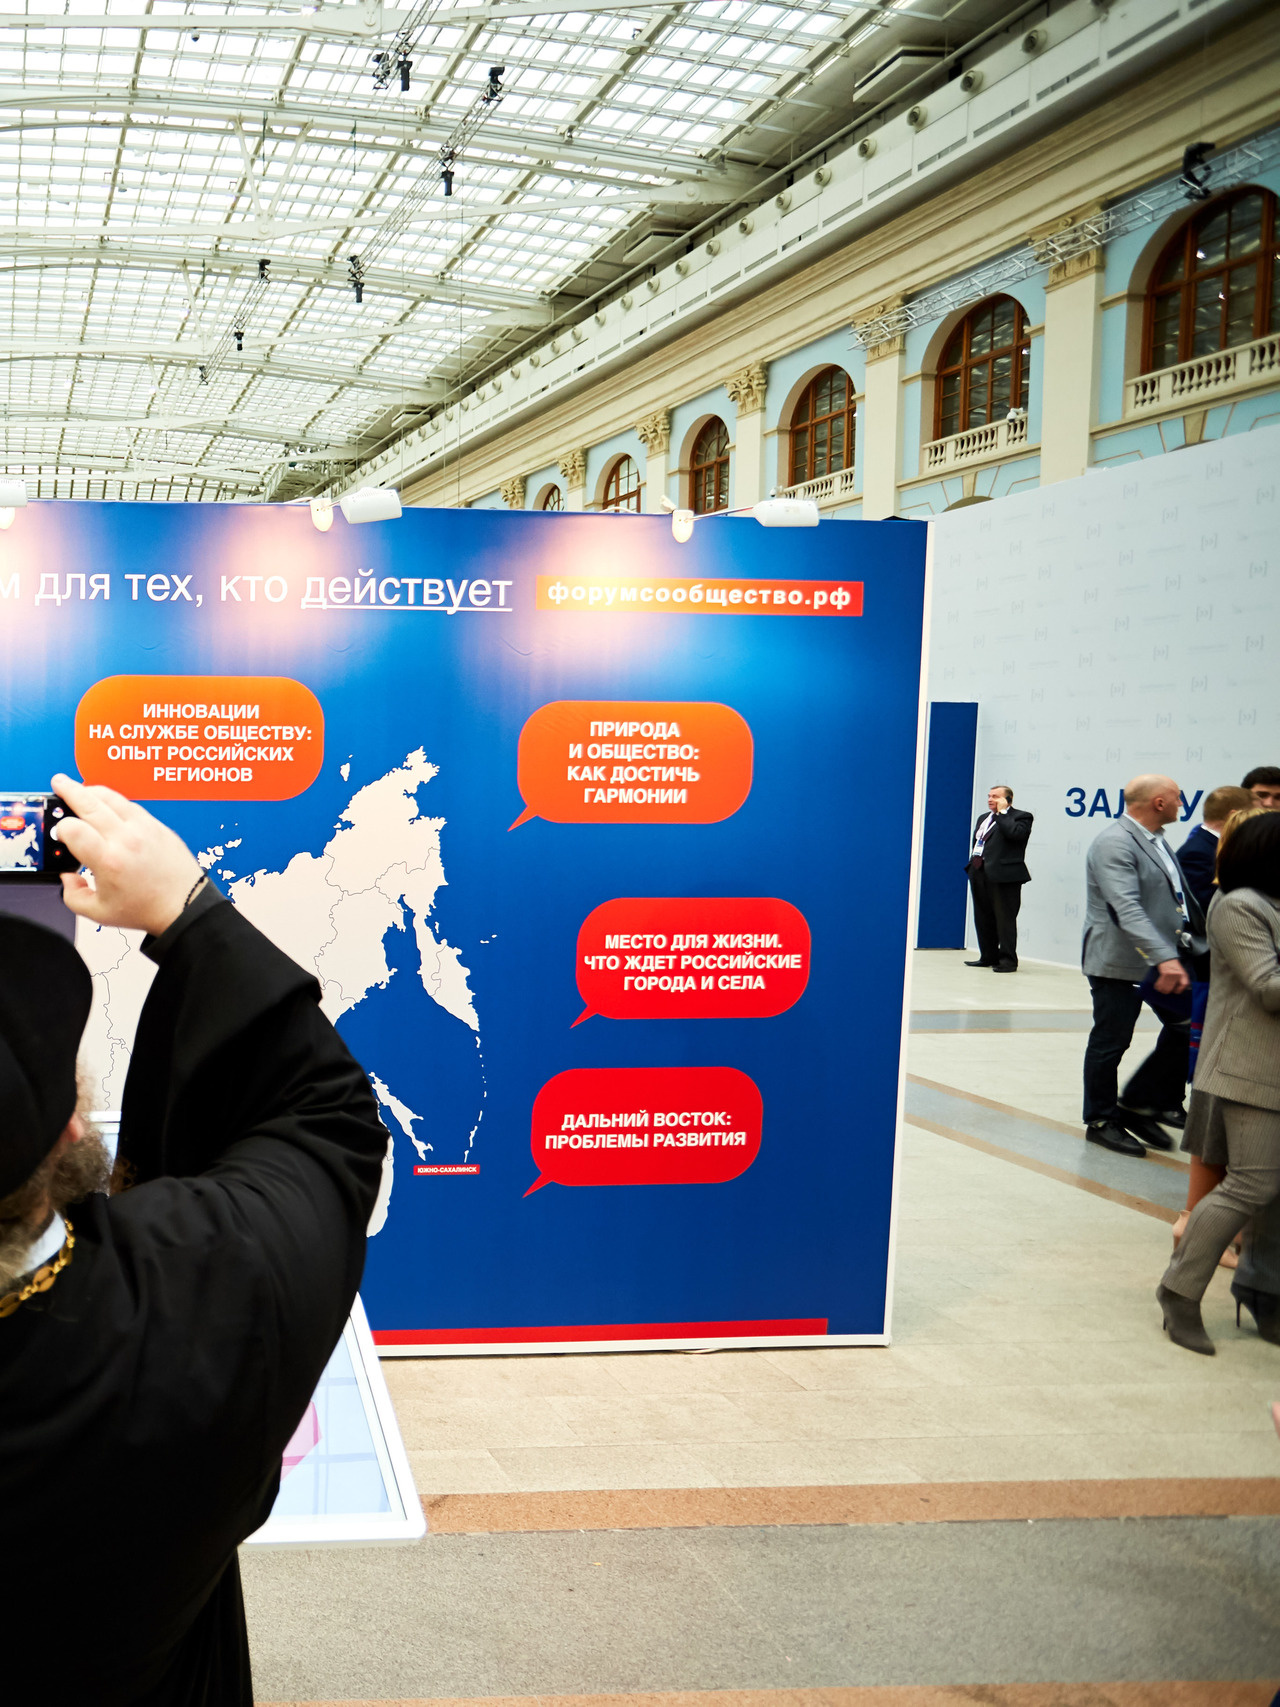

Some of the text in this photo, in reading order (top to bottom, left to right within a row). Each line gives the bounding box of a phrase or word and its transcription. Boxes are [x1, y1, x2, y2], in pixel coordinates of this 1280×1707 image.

[34, 573, 111, 607] для
[124, 573, 204, 608] тех,
[220, 574, 289, 602] кто
[301, 568, 513, 615] действует
[547, 582, 851, 610] форумсообщество.рф
[143, 704, 260, 721] ИННОВАЦИИ
[89, 724, 312, 742] НА СЛУЖБЕ ОБЩЕСТВУ:
[590, 721, 680, 740] ПРИРОДА
[107, 743, 294, 761] ОПЫТ РОССИЙСКИХ
[569, 744, 699, 762] И ОБЩЕСТВО:
[153, 767, 253, 782] РЕГИОНОВ
[567, 766, 700, 784] КАК ДОСТИЧЬ
[584, 788, 687, 803] ГАРМОНИИ
[605, 934, 782, 951] МЕСТО ДЛЯ ЖИЗНИ.
[584, 952, 801, 972] ЧТО ЖДЕТ РОССИЙСКИЕ
[624, 975, 765, 992] ГОРОДА И СЕЛА
[561, 1110, 732, 1130] ДАЛЬНИЙ ВОСТОК:
[545, 1132, 746, 1149] ПРОБЛЕМЫ РАЗВИТИЯ
